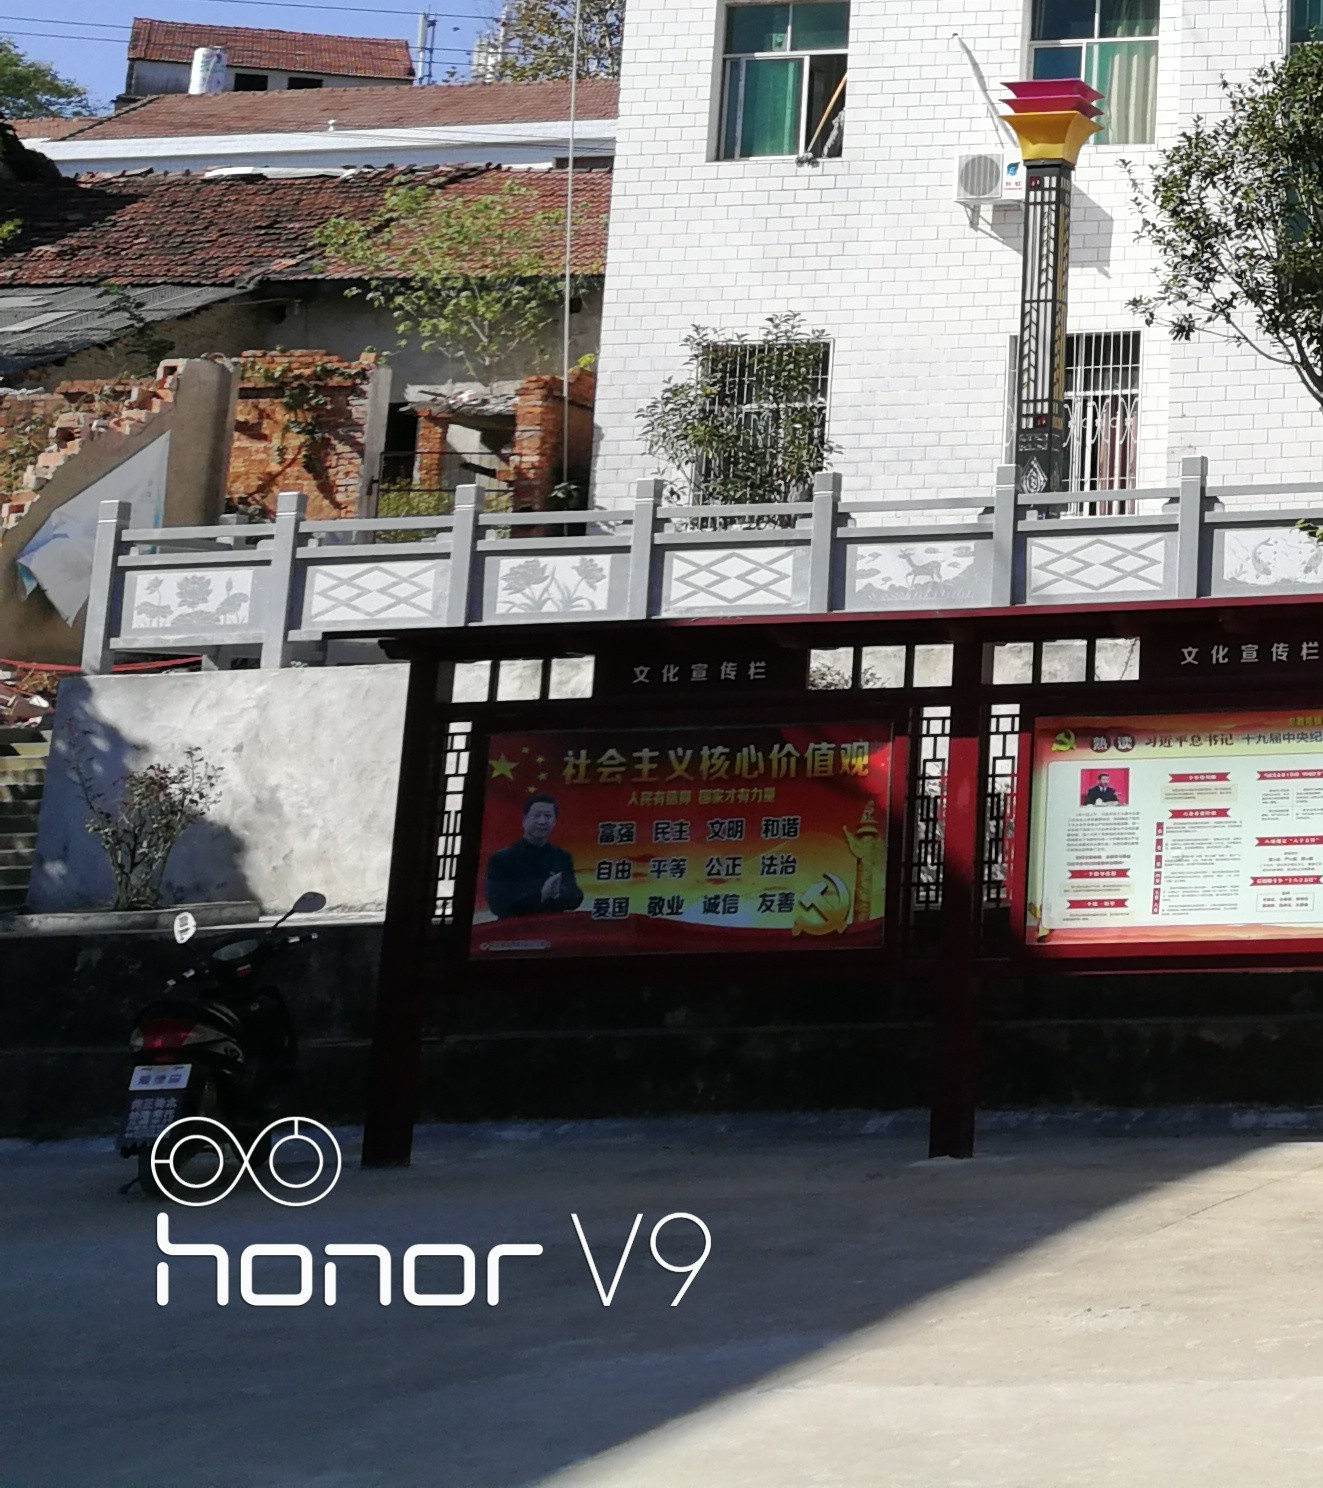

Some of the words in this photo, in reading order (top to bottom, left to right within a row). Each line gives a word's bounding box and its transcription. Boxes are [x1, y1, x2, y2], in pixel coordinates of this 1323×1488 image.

[1180, 641, 1320, 665] 文化宣传栏
[632, 660, 768, 684] 文化宣传栏
[1144, 733, 1235, 748] 习近平总书记
[563, 740, 870, 785] 社会主义核心价值观
[599, 822, 636, 844] 富强
[653, 820, 690, 842] 民主
[708, 818, 745, 841] 文明
[762, 816, 801, 839] 和谐
[596, 860, 633, 880] 自由
[650, 858, 688, 879] 平等
[705, 856, 742, 877] 公正
[760, 854, 797, 876] 法治
[592, 896, 630, 919] 爱国
[646, 895, 685, 917] 敬业
[702, 893, 740, 915] 诚信
[757, 892, 796, 914] 友善
